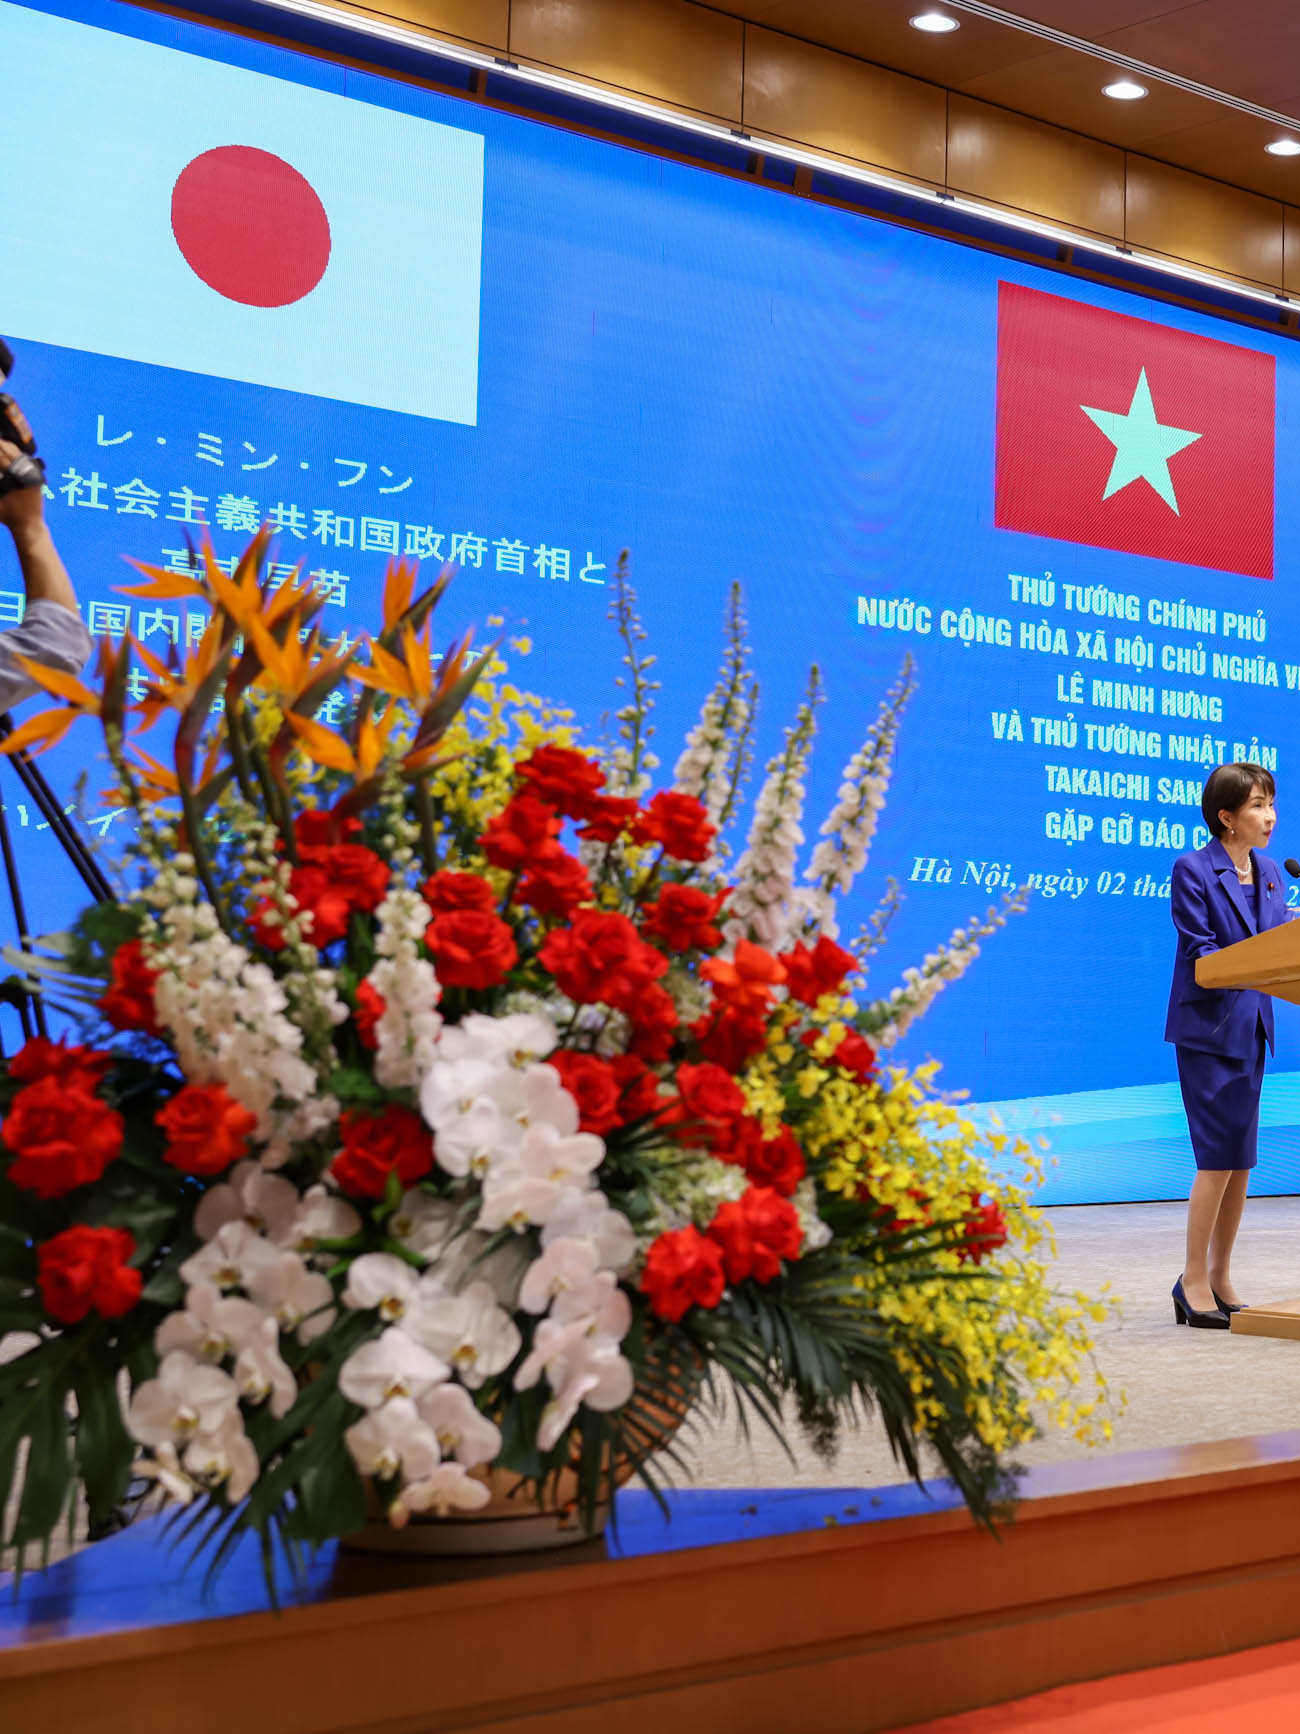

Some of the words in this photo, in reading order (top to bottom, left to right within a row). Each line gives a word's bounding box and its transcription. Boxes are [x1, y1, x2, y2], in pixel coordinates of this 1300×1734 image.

[97, 414, 414, 494] レ・ミン・フン
[41, 466, 607, 585] 社会主義共和国政府首相と
[1007, 571, 1056, 607] THỦ
[1062, 583, 1140, 622] TƯỚNG
[1147, 598, 1217, 635] CHÍNH
[1223, 609, 1267, 643] PHỦ
[857, 595, 932, 635] NƯỚC
[940, 607, 1012, 648] CỘNG
[1019, 618, 1069, 656] HÒA
[1075, 629, 1108, 662] XÃ
[1114, 635, 1154, 673] HỘI
[1161, 641, 1207, 676] CHỦ
[1212, 653, 1279, 687] NGHĨA
[1057, 671, 1084, 705] LÊ
[1092, 679, 1155, 714] MINH
[1161, 689, 1223, 723] HƯNG
[991, 709, 1024, 742] VÀ
[1030, 712, 1078, 748] THỦ
[1084, 722, 1162, 758] TƯỚNG
[1168, 733, 1227, 770] NHẬT
[1232, 736, 1278, 772] BẢN
[1044, 764, 1150, 801] TAKAICHI
[1156, 777, 1203, 807] SAN
[1045, 807, 1094, 846] GẶP
[1101, 812, 1134, 845] GỠ
[1139, 817, 1186, 850] BÁO
[907, 856, 953, 884] Hà
[959, 860, 1017, 894] Nội,
[1026, 868, 1089, 900] ngày
[1097, 871, 1127, 896] 02
[1133, 874, 1172, 898] thá
